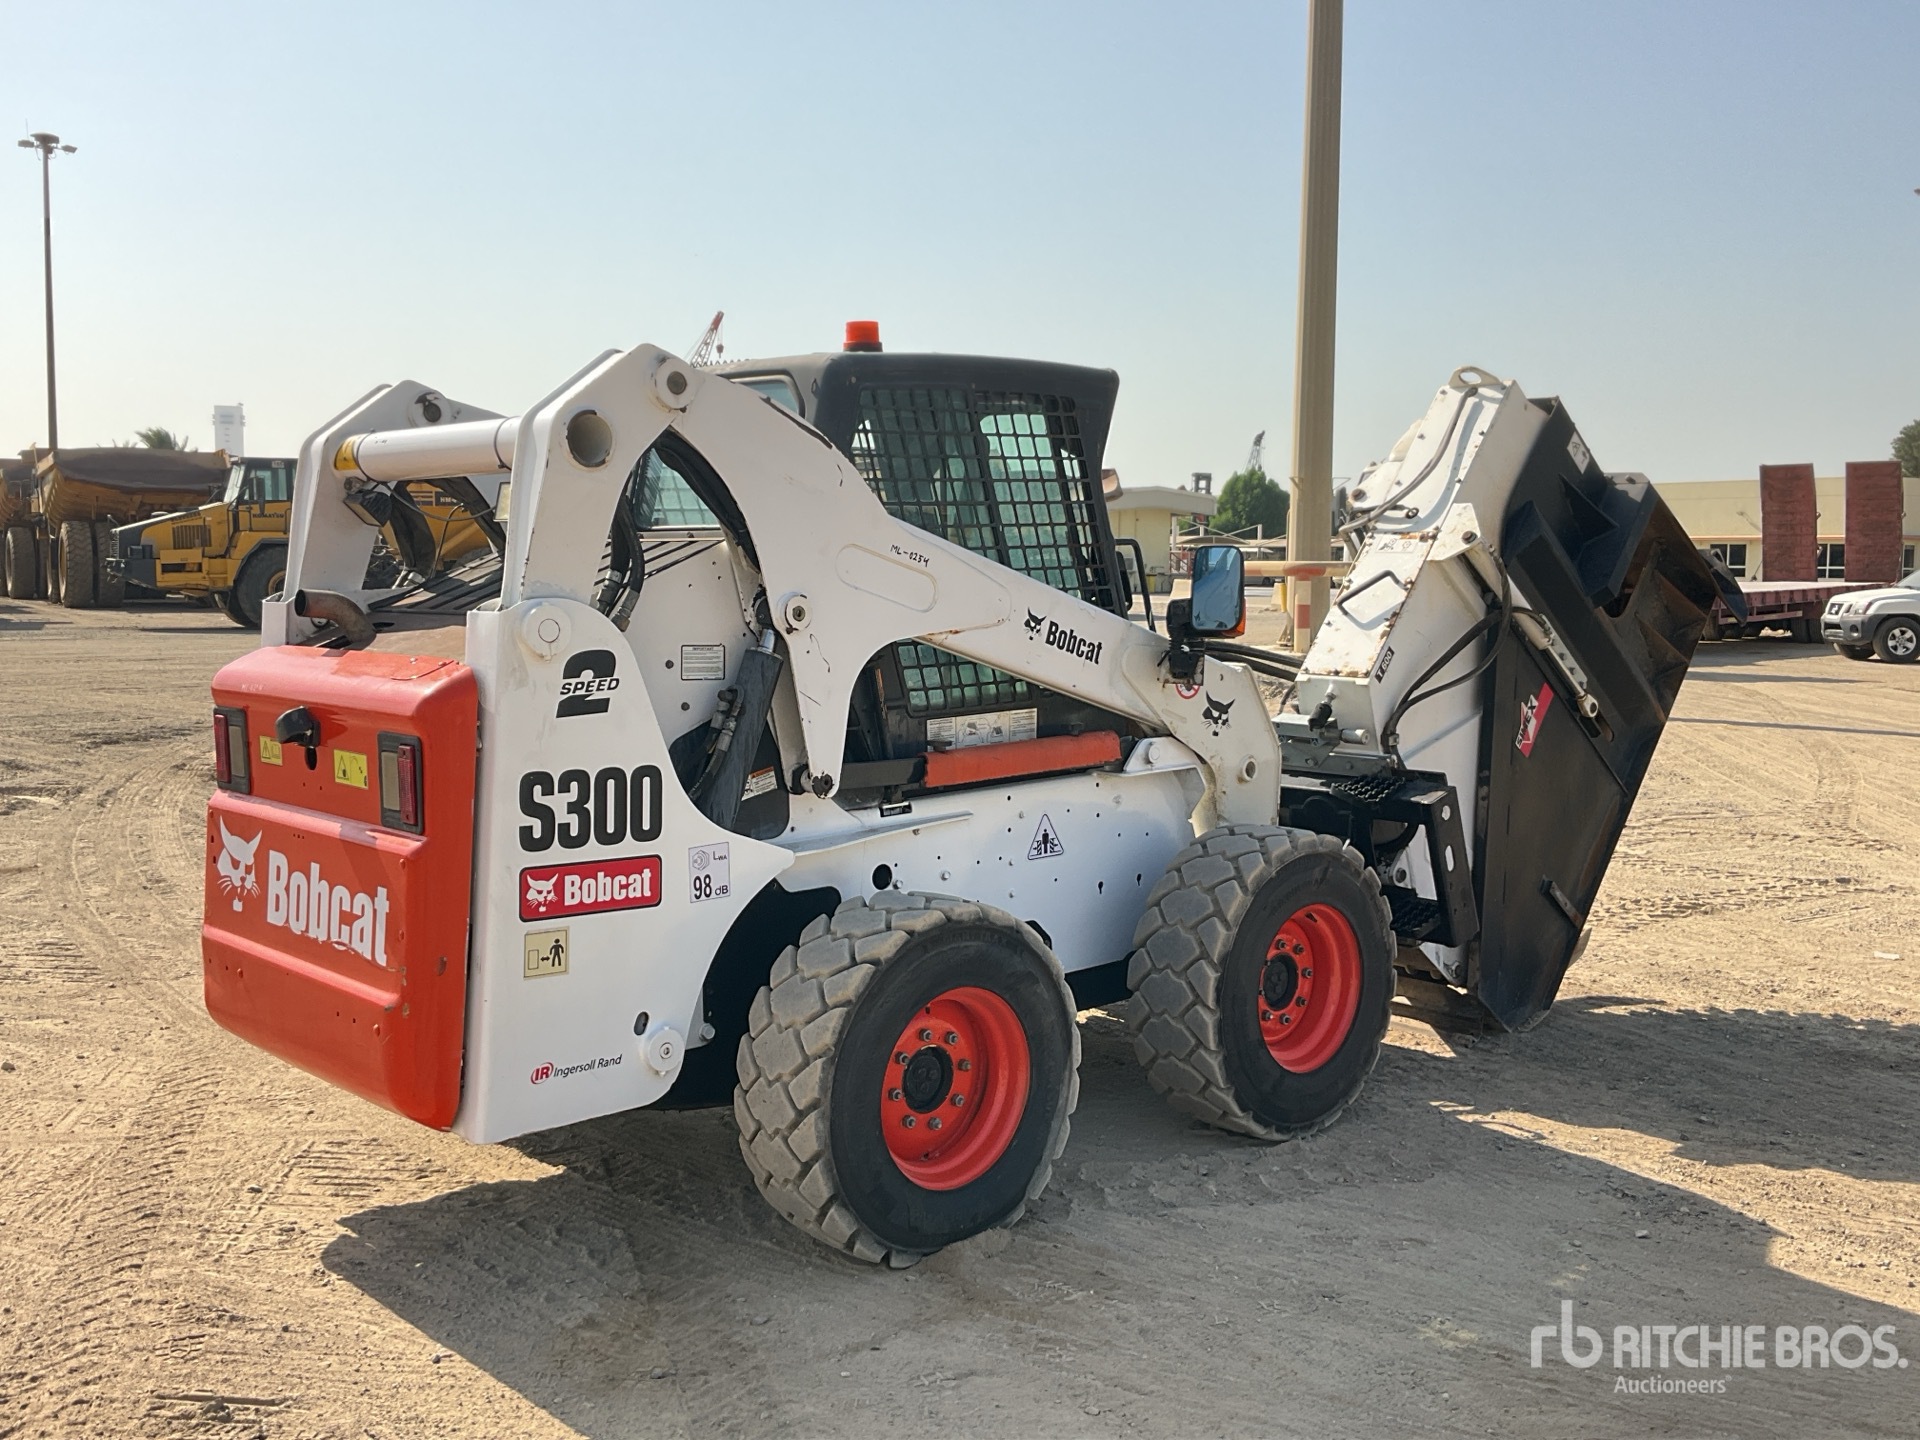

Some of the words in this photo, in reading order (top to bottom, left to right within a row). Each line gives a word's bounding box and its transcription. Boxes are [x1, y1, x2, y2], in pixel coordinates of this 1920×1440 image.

[1045, 620, 1103, 665] Bobcat
[1381, 650, 1392, 670] 600
[560, 678, 620, 696] SPEED
[1516, 698, 1537, 750] SIMEX
[519, 764, 662, 852] S300
[564, 868, 652, 906] Bobcat
[693, 874, 712, 899] 98
[714, 885, 728, 895] dB
[267, 849, 389, 967] Bobcat
[553, 1058, 597, 1078] Ingersoll
[597, 1054, 623, 1069] Rand
